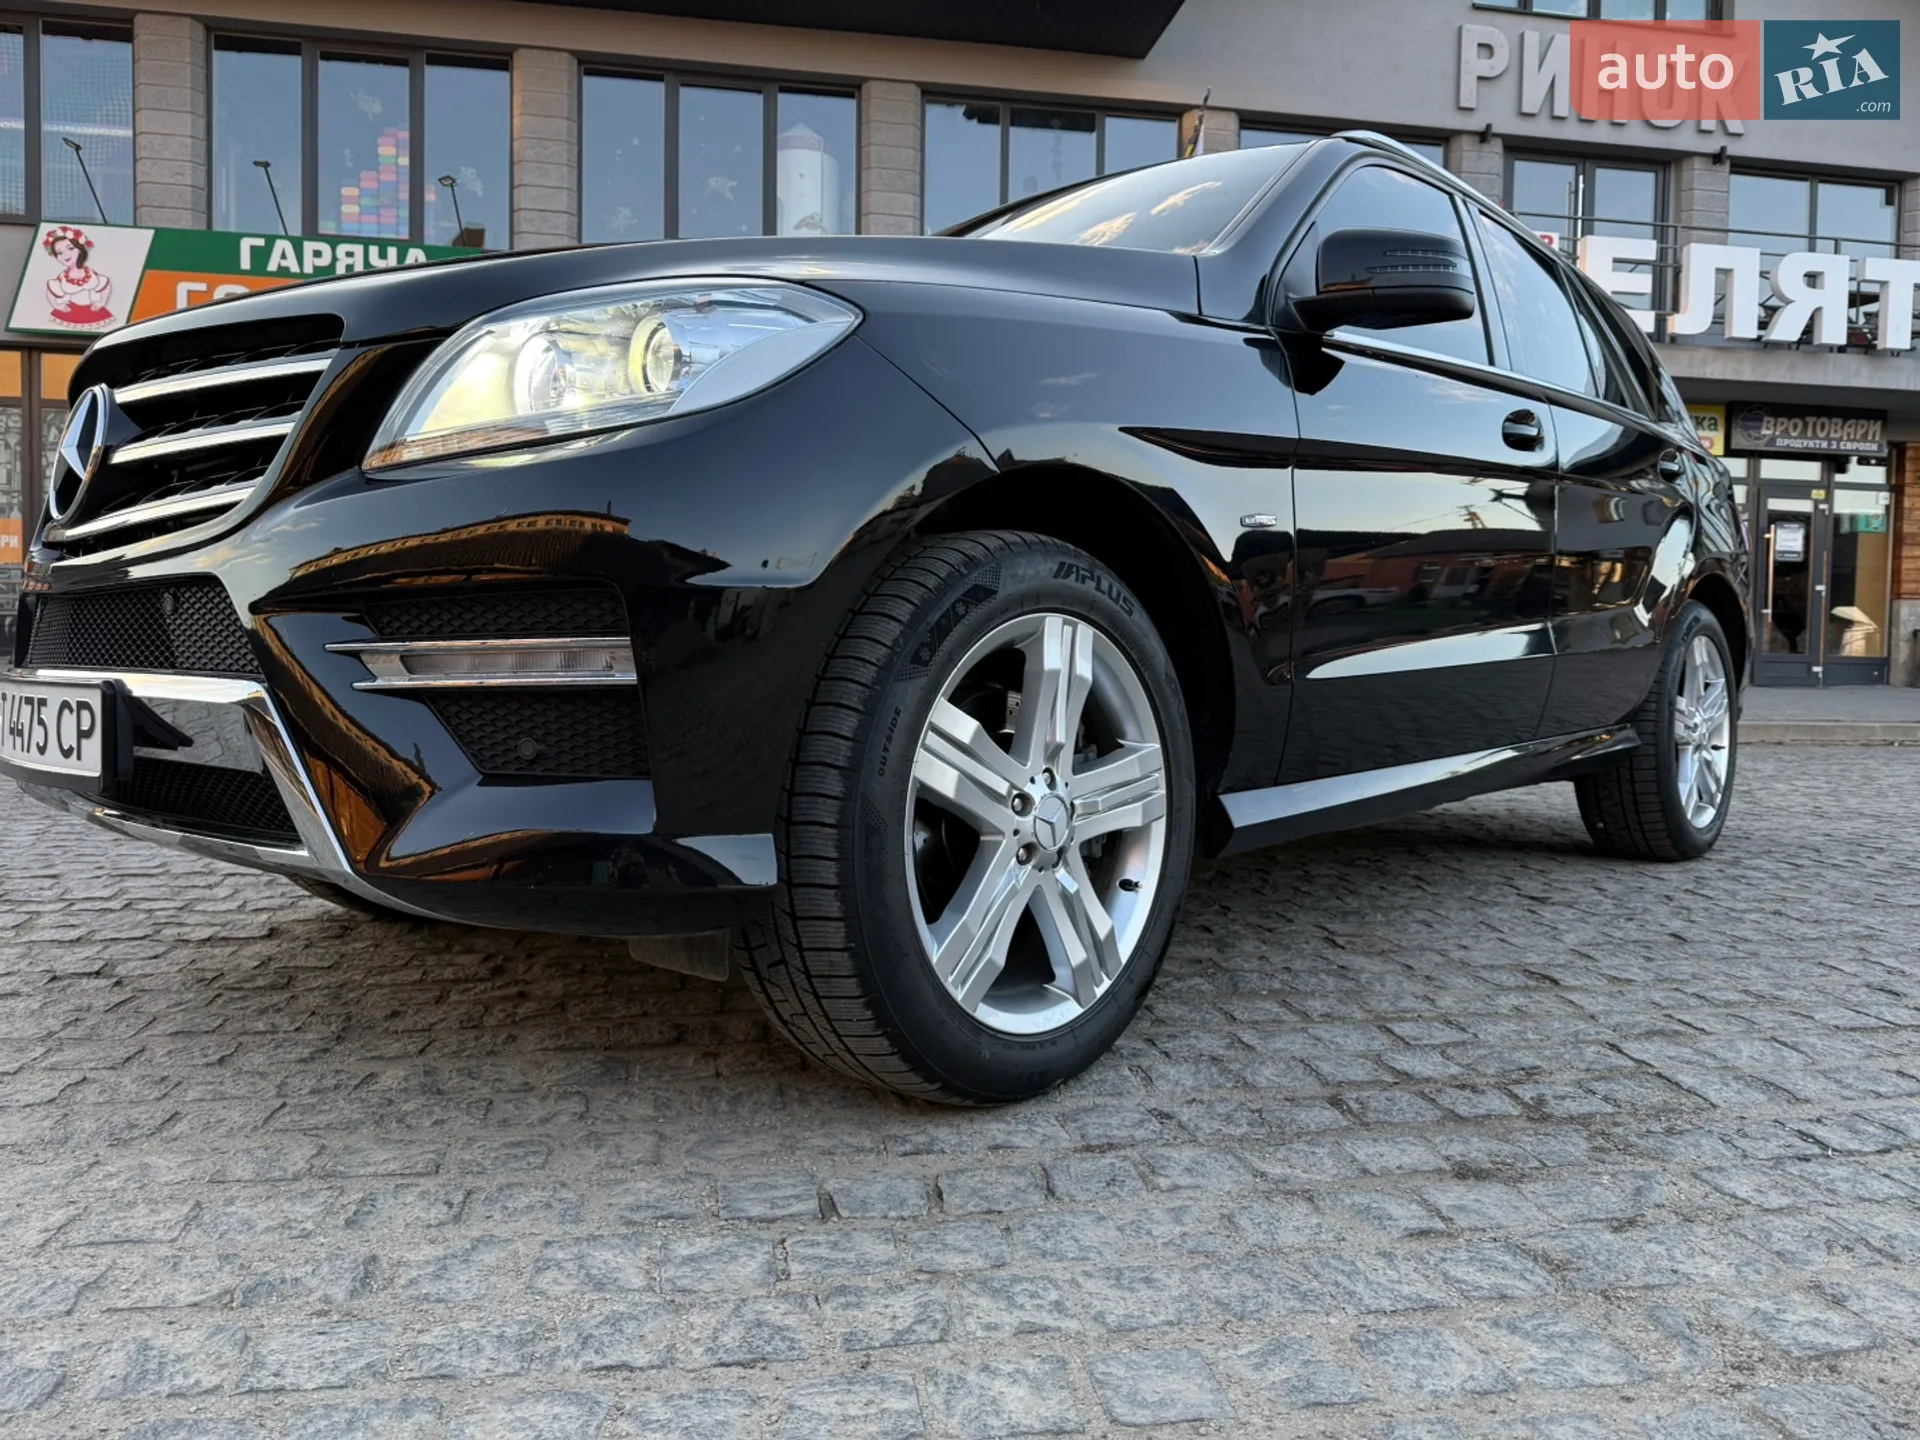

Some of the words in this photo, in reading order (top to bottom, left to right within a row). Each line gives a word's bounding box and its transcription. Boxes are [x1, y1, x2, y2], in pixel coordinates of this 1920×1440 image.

[1457, 23, 1746, 137] РИНОК
[1690, 414, 1719, 432] ка
[1775, 437, 1828, 450] ПРОДУКТИ
[1051, 560, 1135, 618] APLUS
[9, 694, 49, 756] 4475
[56, 698, 96, 761] CP
[877, 704, 903, 778] OUTSIDE
